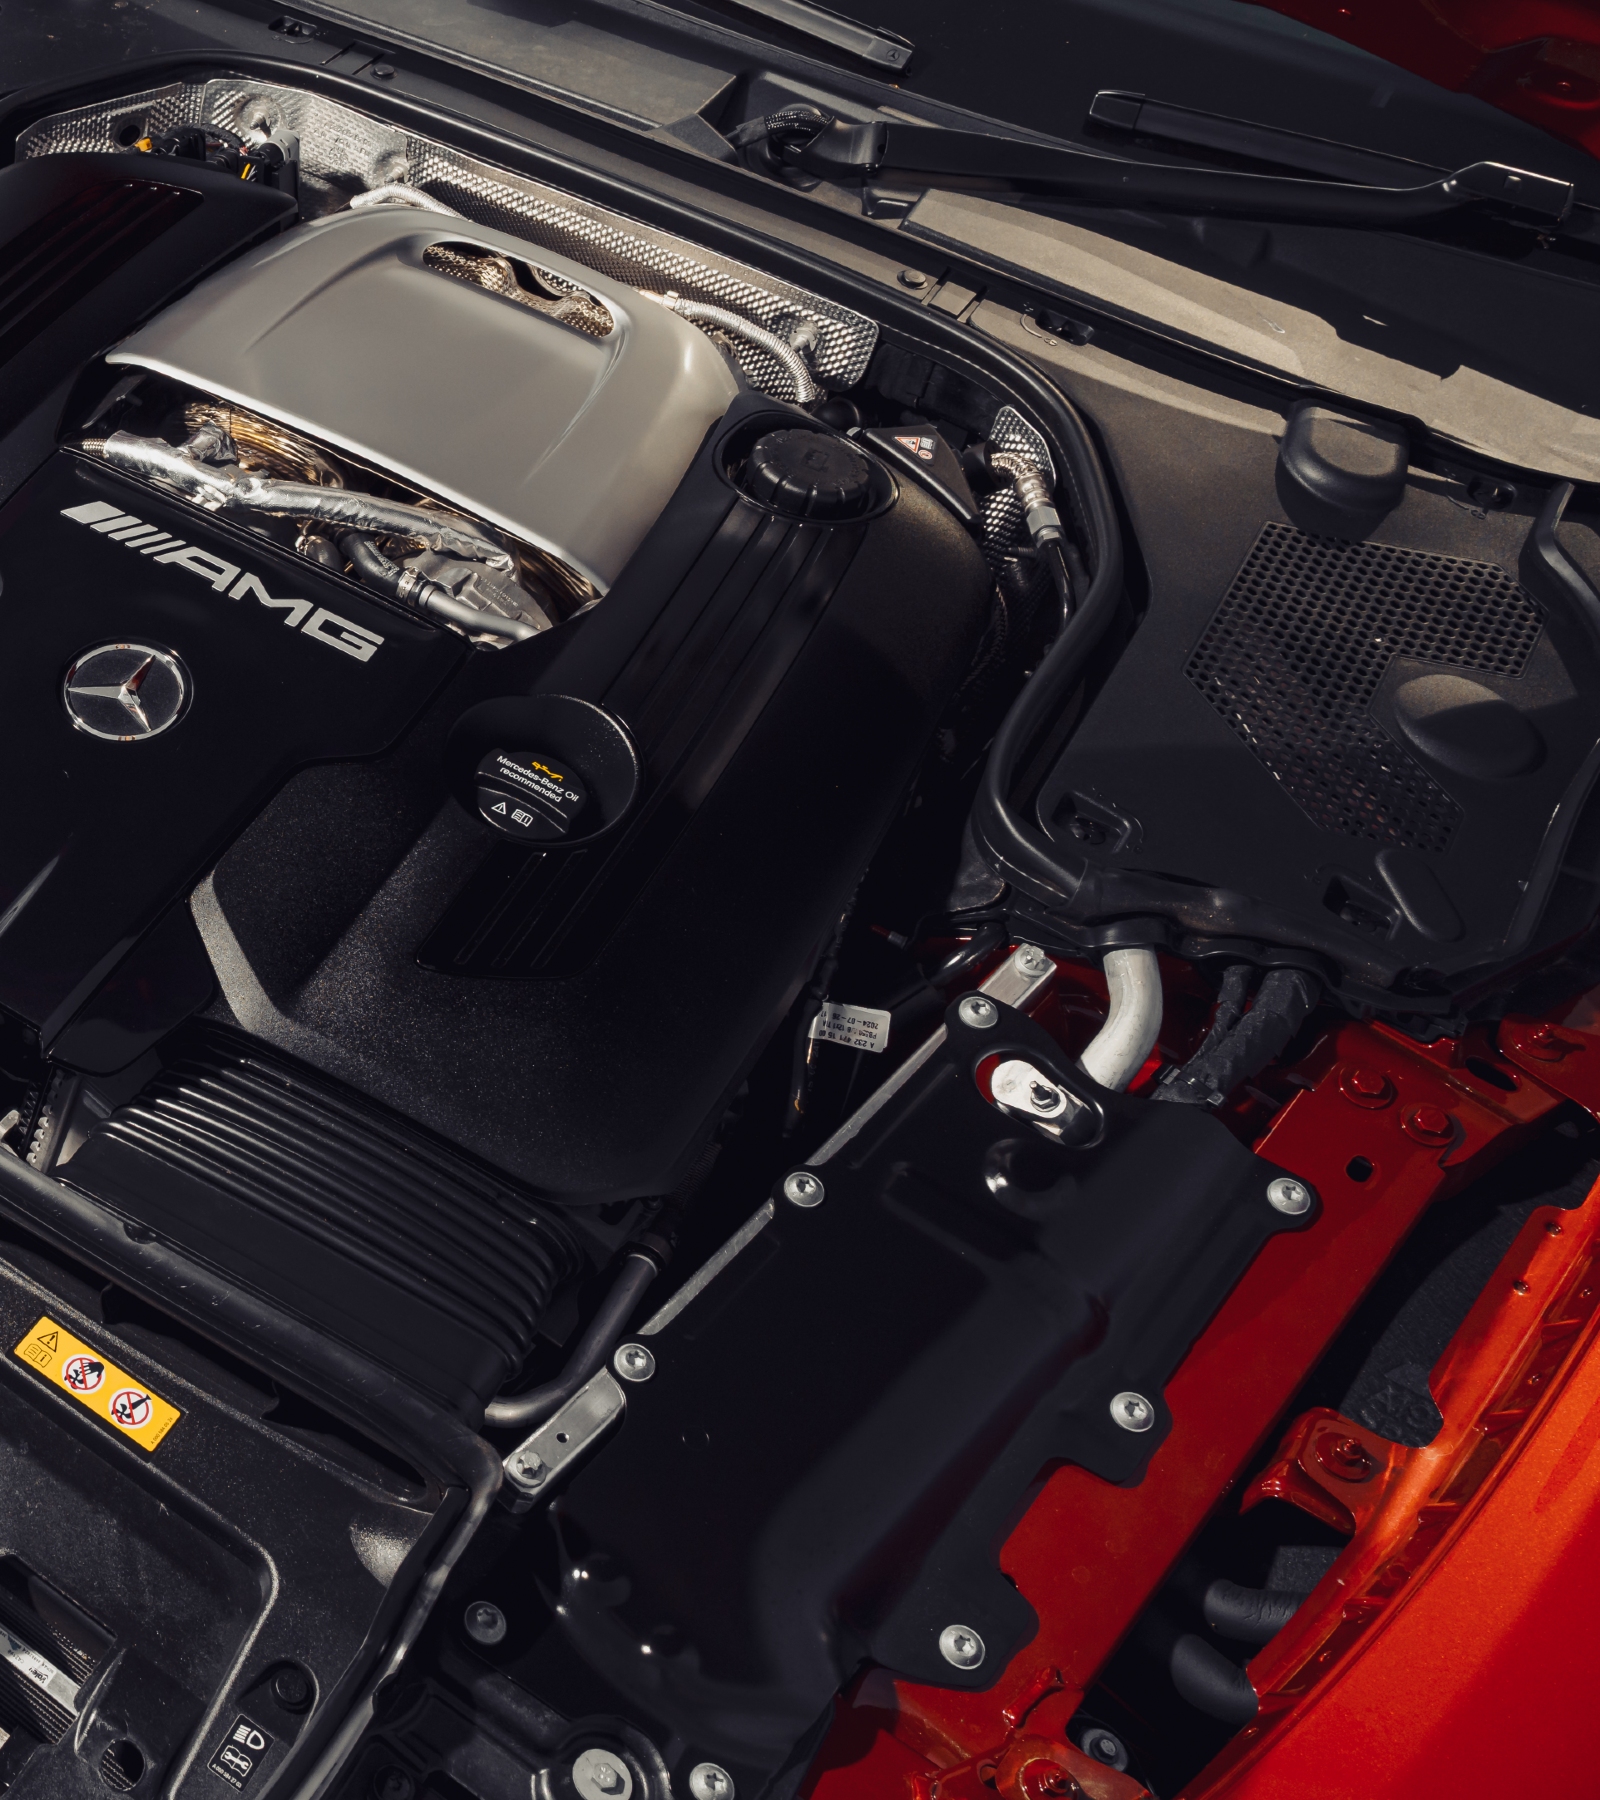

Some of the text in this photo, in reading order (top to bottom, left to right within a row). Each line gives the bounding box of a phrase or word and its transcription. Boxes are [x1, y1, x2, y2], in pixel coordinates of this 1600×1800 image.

[153, 546, 385, 662] AMG
[496, 756, 579, 802] Mercedes-Benz Oil
[500, 767, 562, 802] recommended
